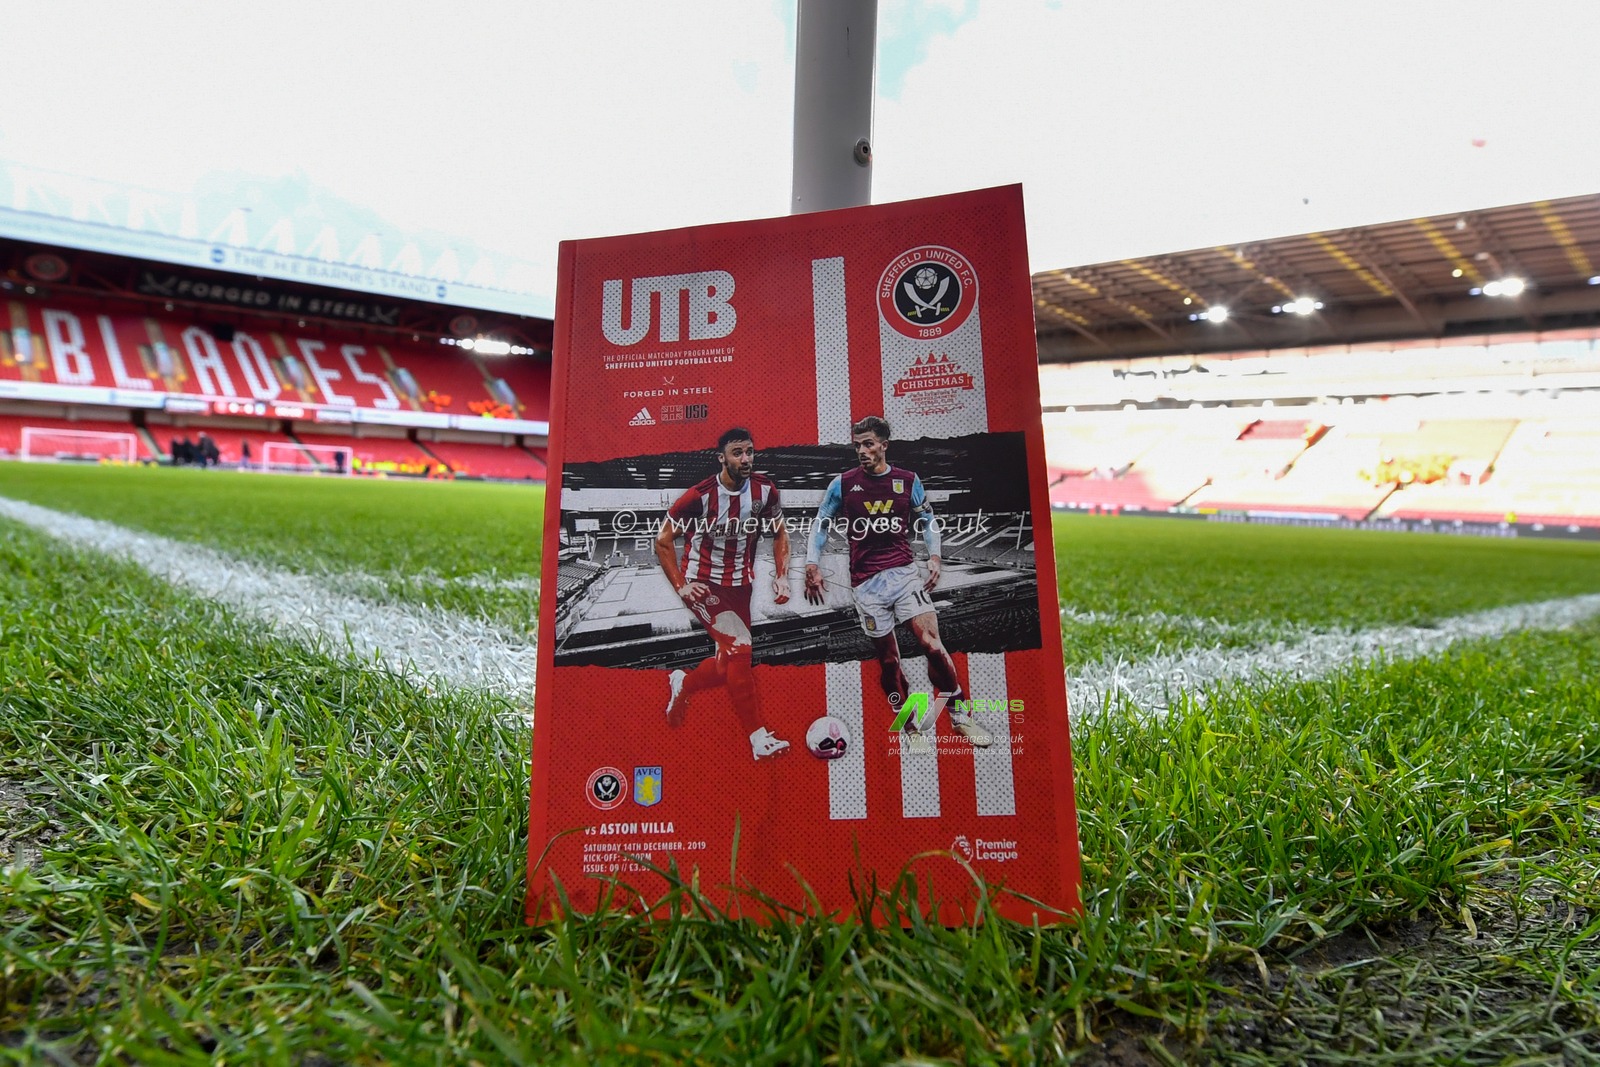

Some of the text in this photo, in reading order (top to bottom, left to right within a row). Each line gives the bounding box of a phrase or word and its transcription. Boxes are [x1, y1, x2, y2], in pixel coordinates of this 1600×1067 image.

[881, 252, 921, 299] SHEFFIELD
[926, 250, 963, 270] UNITED
[177, 280, 366, 319] FORGED IN STEEL
[602, 269, 737, 346] UTB
[918, 327, 942, 337] 1889
[41, 308, 401, 411] BLADES
[616, 353, 646, 362] OFFICIAL
[648, 351, 682, 360] MATCHDAY
[684, 348, 725, 357] PROGRAMME
[605, 355, 733, 370] SHEFFIELD UNITED FOOTBALL CLUB
[908, 364, 956, 377] MERRY
[901, 376, 964, 390] CHRISTMAS
[623, 386, 713, 398] FORGED IN STEEL
[685, 404, 708, 419] USG
[628, 419, 656, 427] adidas
[636, 768, 661, 776] AVFC
[600, 823, 638, 834] ASTON
[641, 822, 674, 834] VILLA
[584, 844, 621, 852] SATURDAY
[624, 843, 642, 851] 14TH
[687, 841, 706, 850] 2019
[975, 838, 1017, 849] Premier
[583, 853, 620, 862] KICK-OFF:
[976, 849, 1018, 862] League
[583, 864, 607, 872] ISSUE:
[609, 863, 620, 872] 09
